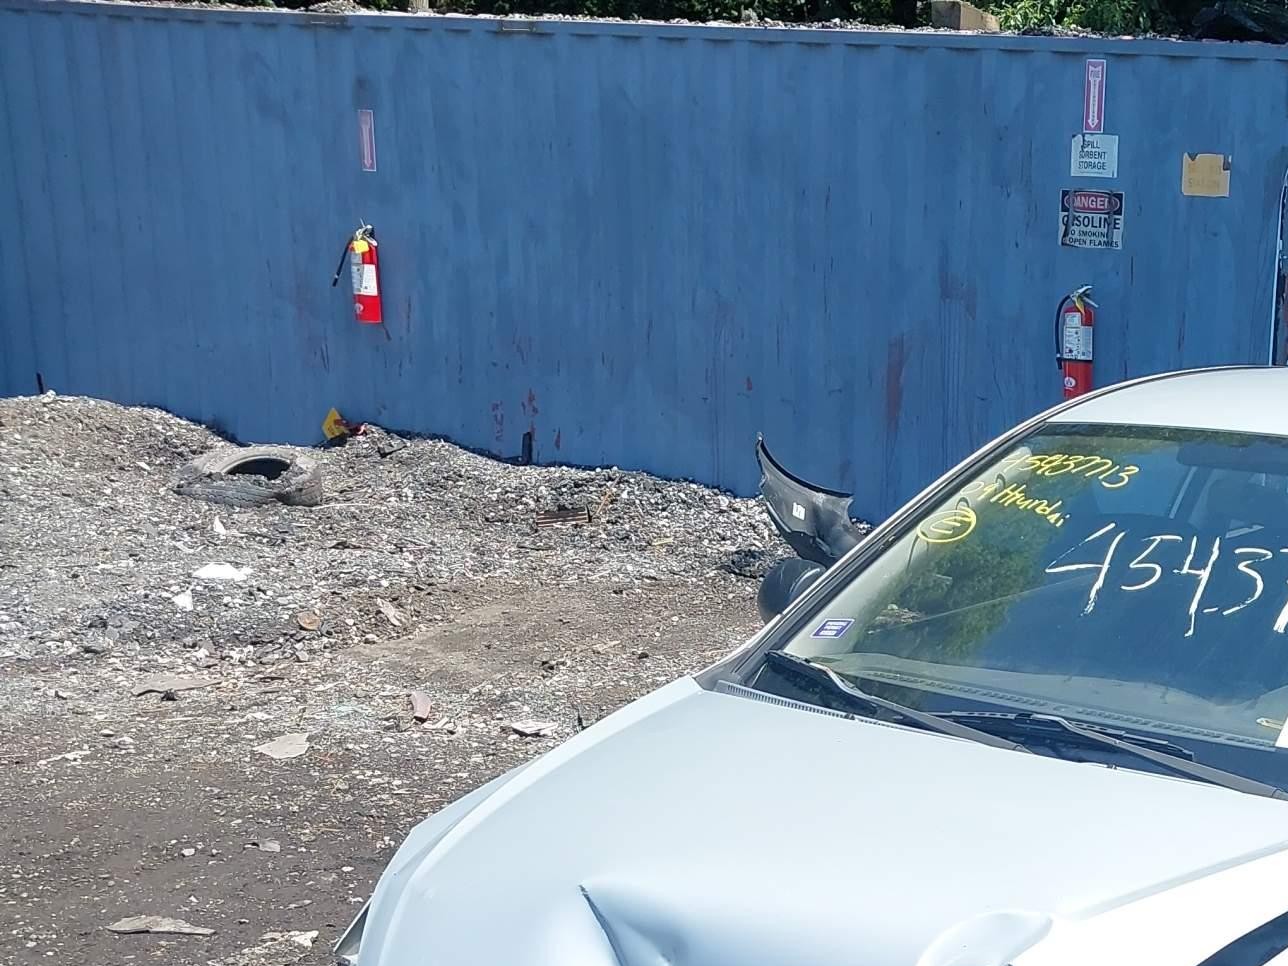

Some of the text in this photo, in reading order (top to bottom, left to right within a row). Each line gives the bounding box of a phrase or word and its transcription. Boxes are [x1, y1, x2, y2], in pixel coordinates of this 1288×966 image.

[1083, 140, 1101, 149] SPILL
[1078, 150, 1107, 161] SORBENT
[1078, 161, 1107, 171] STORAGE
[1062, 214, 1121, 230] GSOLINE
[1078, 230, 1108, 239] SMOKIN
